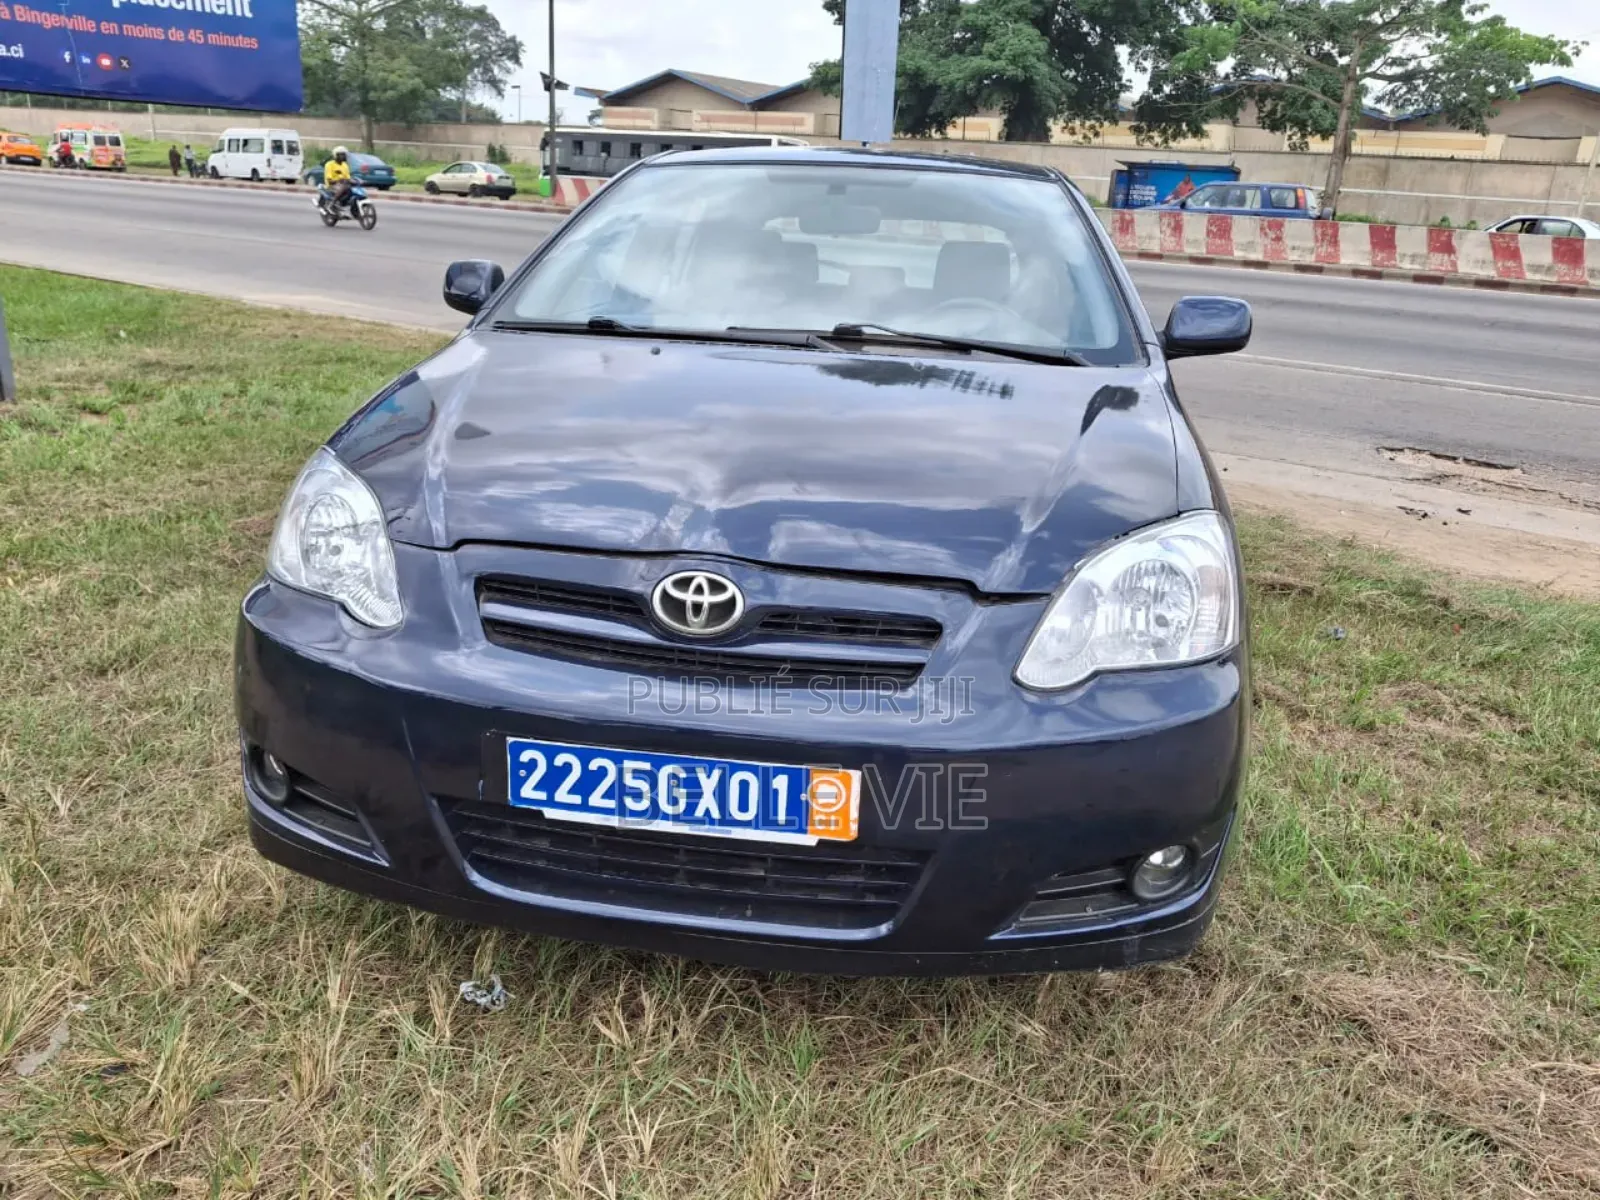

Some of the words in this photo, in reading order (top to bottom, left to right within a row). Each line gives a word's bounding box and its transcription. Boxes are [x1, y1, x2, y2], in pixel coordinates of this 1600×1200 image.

[14, 4, 97, 33] Bingerville
[100, 21, 119, 35] en
[123, 23, 165, 40] moins
[168, 27, 185, 42] de
[188, 29, 205, 44] 45
[208, 33, 259, 49] minutes
[112, 0, 254, 18] ement
[518, 749, 789, 825] 2225GX01
